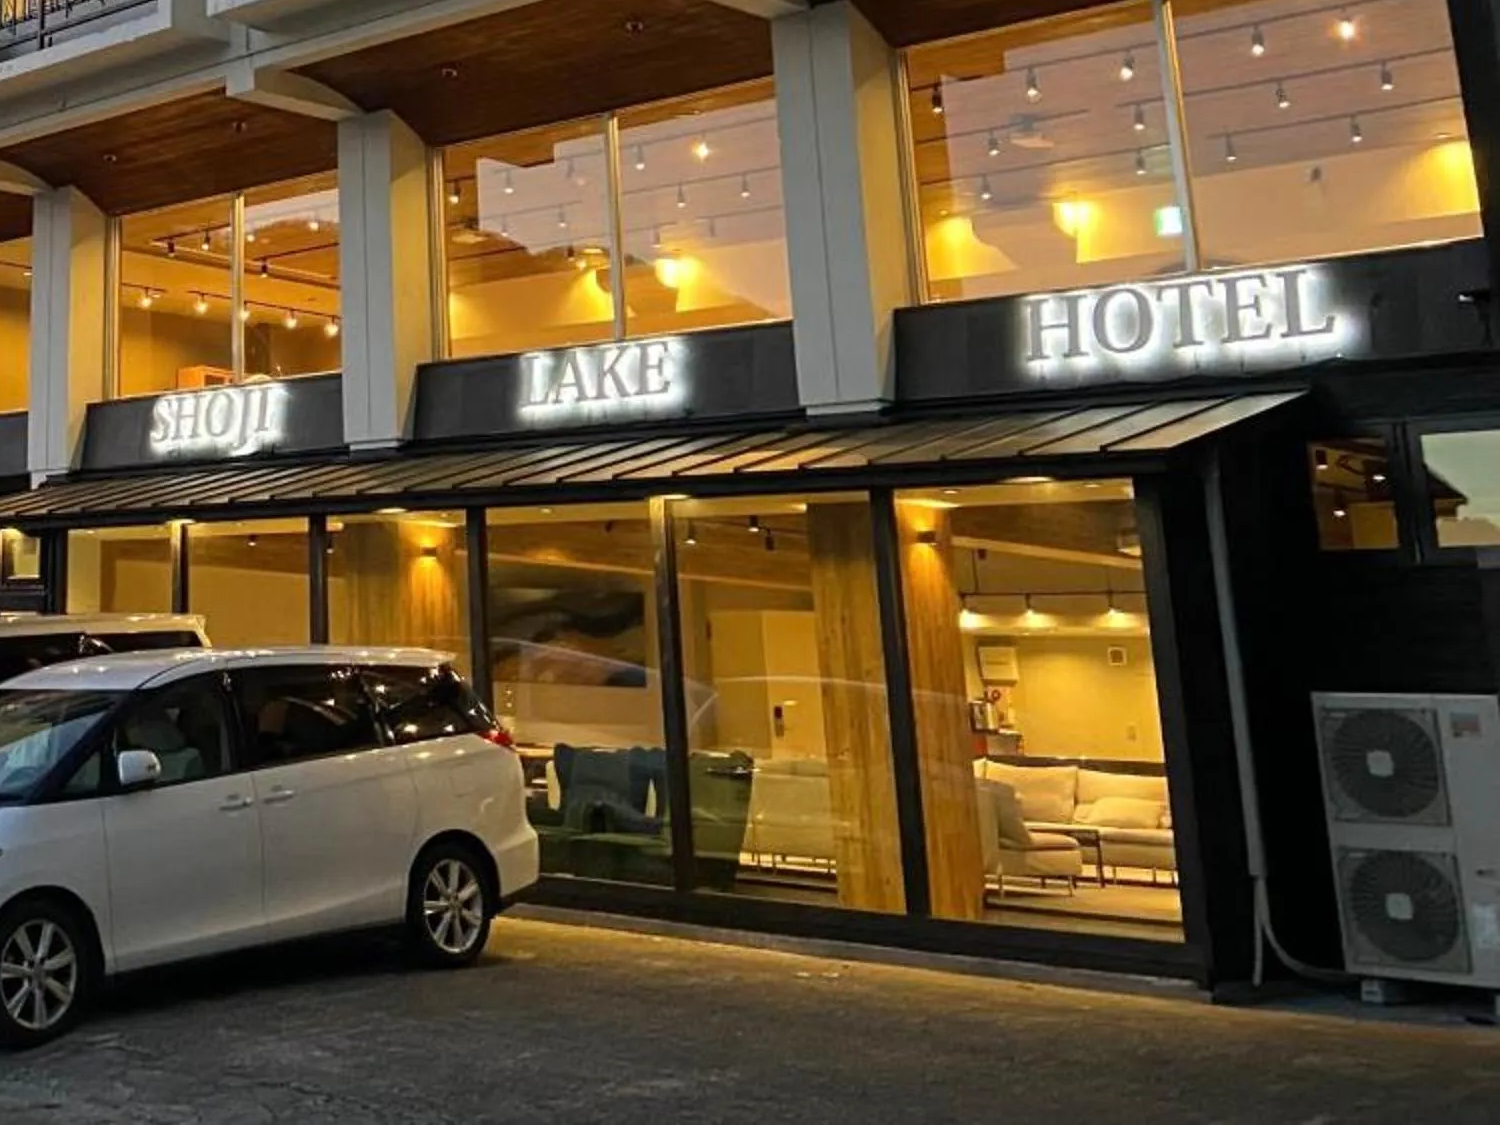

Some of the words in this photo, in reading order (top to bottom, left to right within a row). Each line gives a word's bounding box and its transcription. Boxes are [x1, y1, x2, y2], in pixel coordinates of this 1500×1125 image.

[151, 378, 271, 451] SHOJI
[519, 341, 671, 407] LAKE
[1025, 269, 1335, 361] HOTEL
